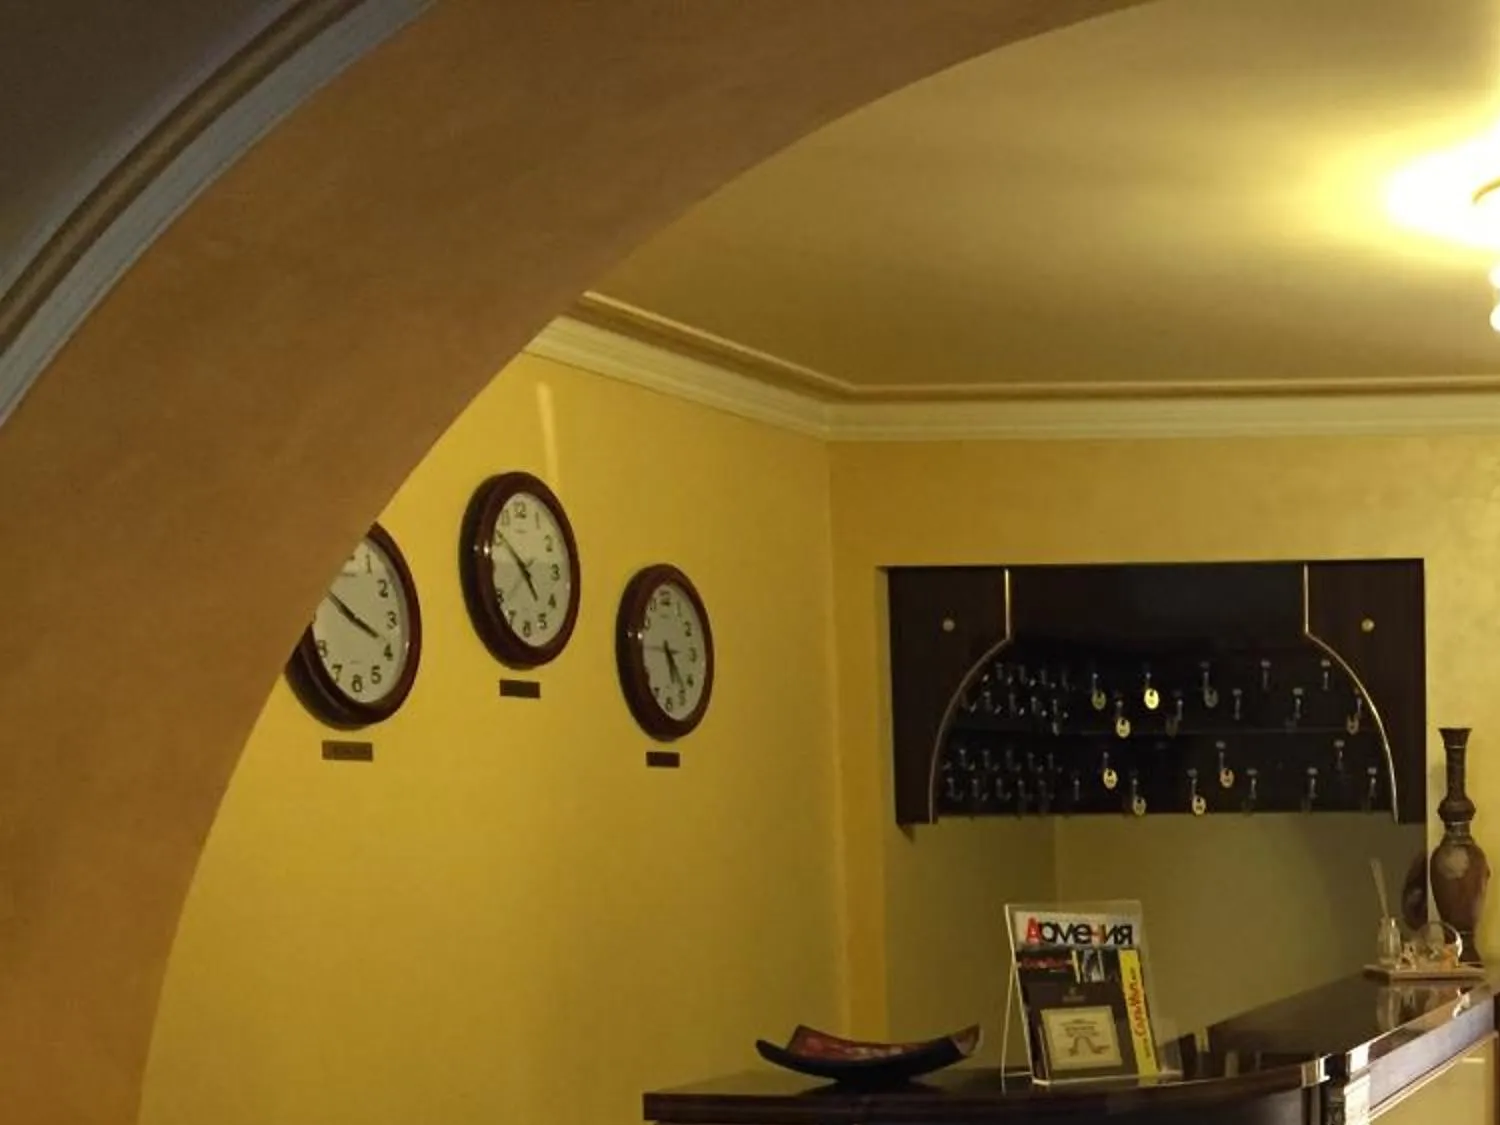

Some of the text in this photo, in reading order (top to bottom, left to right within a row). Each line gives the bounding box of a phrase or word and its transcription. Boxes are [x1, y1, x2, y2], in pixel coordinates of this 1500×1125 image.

[544, 534, 554, 553] 2
[363, 553, 373, 575] 1
[550, 563, 561, 582] 3
[377, 578, 389, 599] 2
[386, 610, 398, 630] 3
[507, 609, 517, 626] 7
[537, 612, 548, 630] 5
[383, 642, 394, 662] 4
[331, 663, 343, 683] 7
[370, 664, 383, 685] 5
[351, 673, 363, 694] 6
